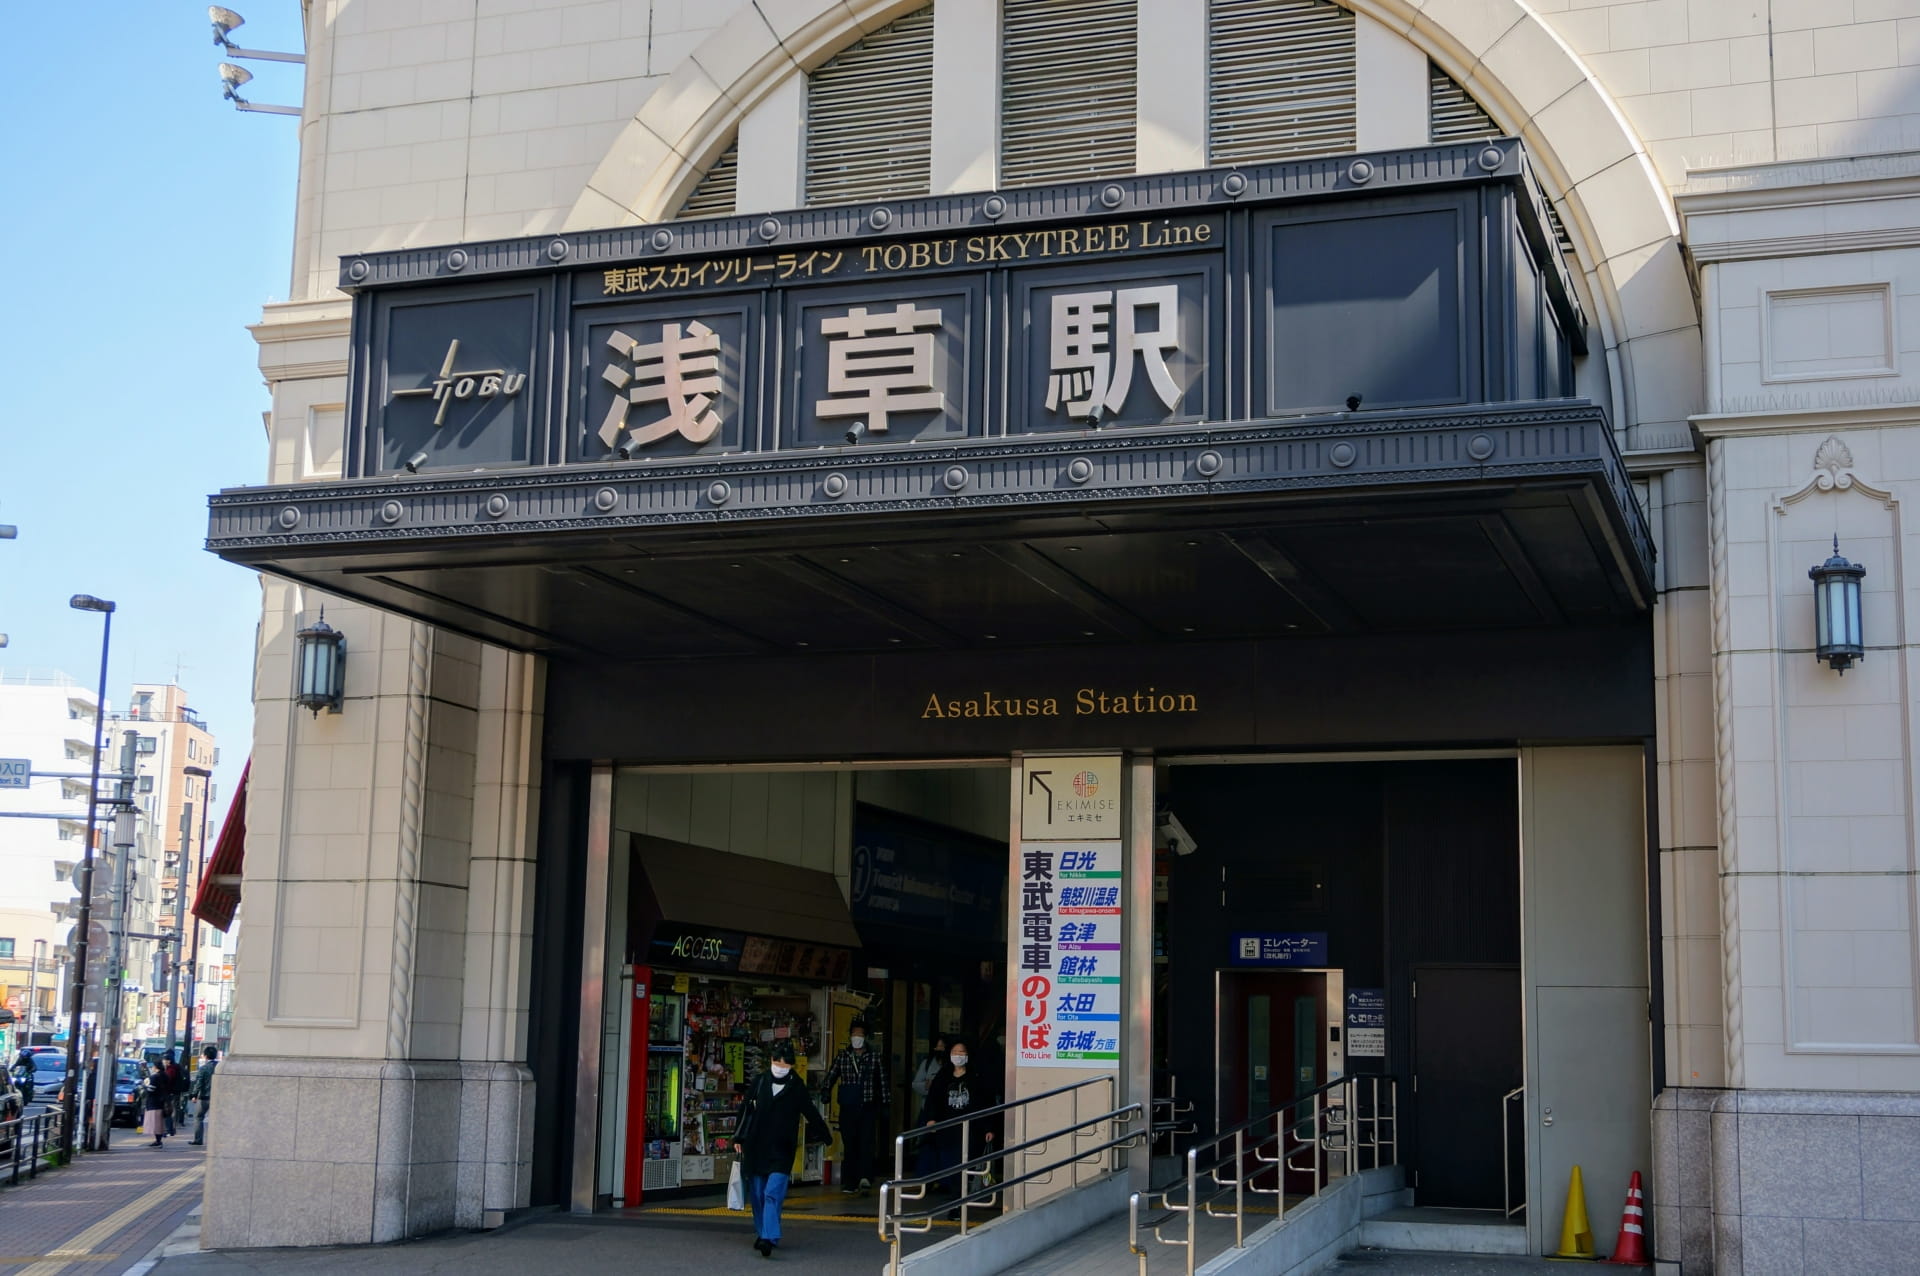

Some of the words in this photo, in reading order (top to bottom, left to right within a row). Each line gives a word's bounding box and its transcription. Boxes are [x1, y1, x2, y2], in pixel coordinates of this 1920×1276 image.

[862, 239, 957, 273] TOBU
[966, 224, 1130, 264] SKYTREE
[1138, 219, 1212, 248] Line
[602, 250, 843, 296] 東武スカイツリーライン
[599, 284, 1183, 449] 浅草駅
[431, 373, 527, 401] TOBU
[921, 692, 1060, 720] Asakusa
[1075, 687, 1200, 716] Station
[1057, 799, 1116, 811] EKIMISE
[1067, 813, 1103, 823] エキミセ
[1059, 851, 1097, 871] 日光
[1058, 886, 1119, 907] 鬼怒川温泉
[1058, 922, 1097, 942] 会津
[671, 935, 722, 961] ACCESS
[1022, 850, 1054, 1050] 東武電車のりば
[1263, 938, 1319, 948] エレベーター
[1057, 955, 1098, 976] 館林
[1056, 992, 1097, 1012] 太田
[1021, 1051, 1037, 1059] Tobu
[1037, 1051, 1052, 1059] Line
